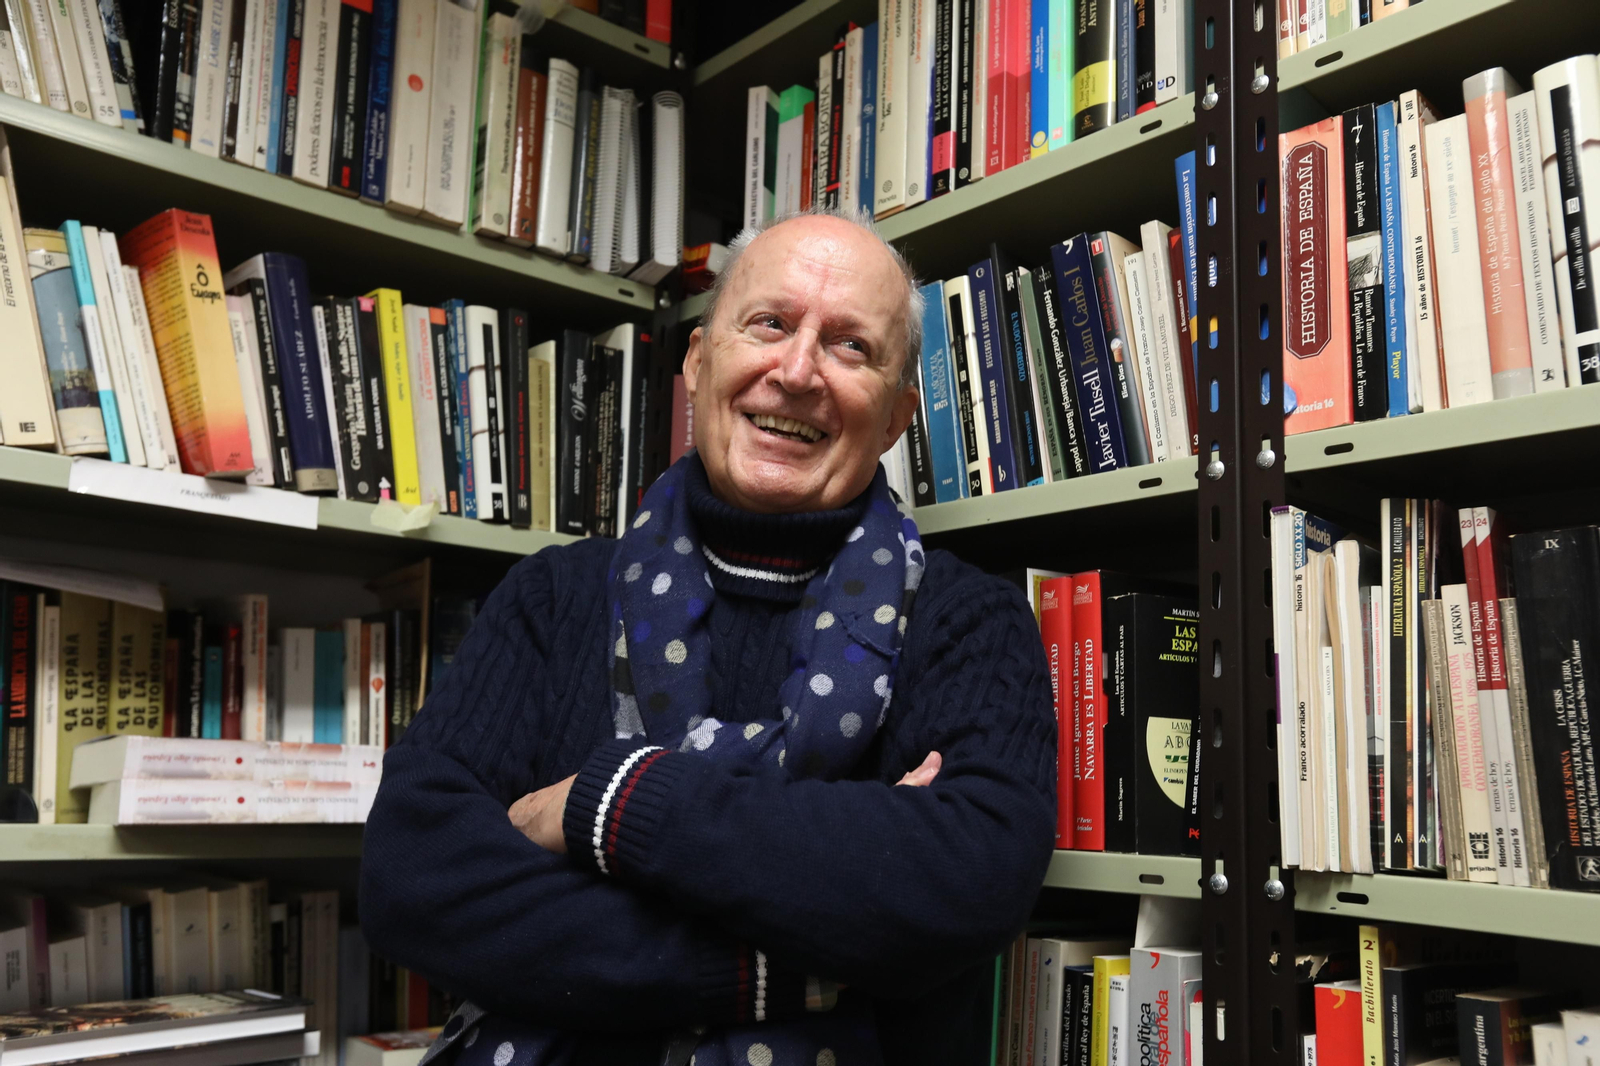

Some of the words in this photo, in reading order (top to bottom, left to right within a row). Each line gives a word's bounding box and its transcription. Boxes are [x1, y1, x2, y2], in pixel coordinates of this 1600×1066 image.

[1521, 106, 1532, 138] PEINADO
[1408, 144, 1417, 152] 16
[1477, 152, 1489, 167] XX
[1524, 139, 1533, 158] LARA
[1182, 169, 1191, 182] La
[1354, 160, 1365, 190] Historia
[1409, 153, 1418, 178] historia
[1525, 159, 1536, 191] FEDERICO
[1296, 152, 1314, 222] ESPAÑA
[1355, 190, 1365, 201] de
[1478, 170, 1493, 195] siglo
[1183, 183, 1196, 233] construcción
[1356, 203, 1367, 228] España
[1481, 197, 1494, 214] del
[1483, 216, 1500, 253] España
[1526, 201, 1540, 249] HISTÓRICOS
[1299, 227, 1314, 251] DE
[1414, 235, 1422, 244] 16
[1064, 265, 1081, 274] I
[1414, 245, 1426, 282] HISTORIA
[1488, 255, 1499, 270] de
[1531, 249, 1542, 279] TEXTOS
[1353, 290, 1363, 299] La
[1416, 282, 1425, 293] de
[1490, 272, 1504, 315] Historia
[1534, 280, 1543, 291] DE
[1043, 290, 1058, 328] Fernando
[1066, 275, 1090, 327] Carlos
[1300, 256, 1317, 346] HISTORIA
[1365, 288, 1375, 315] Ramón
[1417, 293, 1427, 311] años
[1012, 319, 1021, 339] NUDO
[1351, 302, 1365, 341] República.
[1420, 313, 1428, 321] 15
[1535, 292, 1549, 346] COMENTARIO
[1077, 327, 1099, 367] Juan
[1158, 314, 1171, 361] VILLAMURIEL
[1366, 315, 1376, 353] Tamames
[1013, 341, 1026, 381] CORREDIZO
[1049, 329, 1064, 368] González
[1356, 343, 1366, 354] La
[1356, 355, 1364, 368] era
[1115, 363, 1126, 380] Díaz
[1163, 361, 1172, 371] DE
[1357, 369, 1367, 378] de
[1391, 350, 1402, 379] Playor
[1581, 356, 1600, 372] 38
[425, 388, 434, 401] LA
[569, 358, 587, 421] Wellington
[1081, 367, 1107, 421] Tusell
[1163, 372, 1175, 394] PÉREZ
[1357, 379, 1368, 407] Franco
[1167, 394, 1179, 417] DIEGO
[373, 406, 383, 434] CULTURA
[347, 421, 363, 470] Gregorio
[376, 434, 384, 450] UNA
[1094, 421, 1118, 470] Javier
[1070, 446, 1083, 473] poder
[1305, 518, 1331, 547] historia
[1392, 517, 1403, 553] BACHILLERATO
[1461, 520, 1473, 529] 23
[1476, 518, 1488, 527] 24
[1418, 550, 1426, 570] ESPAÑOLA
[1294, 573, 1303, 582] 16
[1391, 564, 1403, 597] ESPAÑOLA
[1418, 570, 1426, 593] LITERATURA
[1294, 584, 1303, 612] historia
[1393, 597, 1404, 637] LITERATURA
[1450, 604, 1466, 645] JACKSON
[1470, 601, 1484, 632] España
[1485, 600, 1499, 632] España
[1175, 626, 1197, 639] LAS
[1472, 634, 1483, 646] de
[1487, 633, 1498, 645] de
[64, 634, 79, 701] ESPAÑA
[117, 634, 133, 699] ESPAÑA
[1073, 642, 1082, 677] Burgo
[1083, 638, 1095, 701] LIBERTAD
[1463, 652, 1474, 670] 1975
[1474, 648, 1487, 682] Historia
[1488, 646, 1502, 682] Historia
[82, 671, 94, 698] LAS
[134, 671, 146, 698] LAS
[1465, 678, 1478, 697] 1898
[10, 704, 27, 718] LA
[1085, 703, 1095, 718] ES
[1553, 688, 1565, 714] CRISIS
[64, 708, 77, 731] LA
[82, 708, 93, 727] DE
[117, 707, 130, 730] LA
[133, 707, 145, 725] DE
[1073, 700, 1082, 743] Ignacio
[1298, 701, 1307, 749] acorralado
[1557, 715, 1567, 726] LA
[1084, 720, 1096, 781] NAVARRA
[1467, 702, 1487, 791] CONTEMPORANEA
[1073, 746, 1082, 781] Jaime
[1299, 750, 1308, 781] Franco
[1560, 750, 1574, 785] ESPAÑA
[1566, 786, 1576, 800] DE
[1191, 806, 1198, 815] EL
[1568, 801, 1581, 847] HISTORIA
[1495, 827, 1504, 836] 16
[1511, 827, 1520, 836] 16
[1496, 837, 1507, 868] Historia
[1511, 838, 1523, 868] Historia
[1063, 984, 1072, 1014] Estado
[1082, 985, 1091, 1014] España
[1363, 959, 1375, 1024] Bachillerato
[1063, 1016, 1071, 1031] del
[1081, 1015, 1089, 1026] de
[1062, 1033, 1070, 1062] orillas
[1081, 1026, 1090, 1043] Rey
[1080, 1044, 1088, 1054] al
